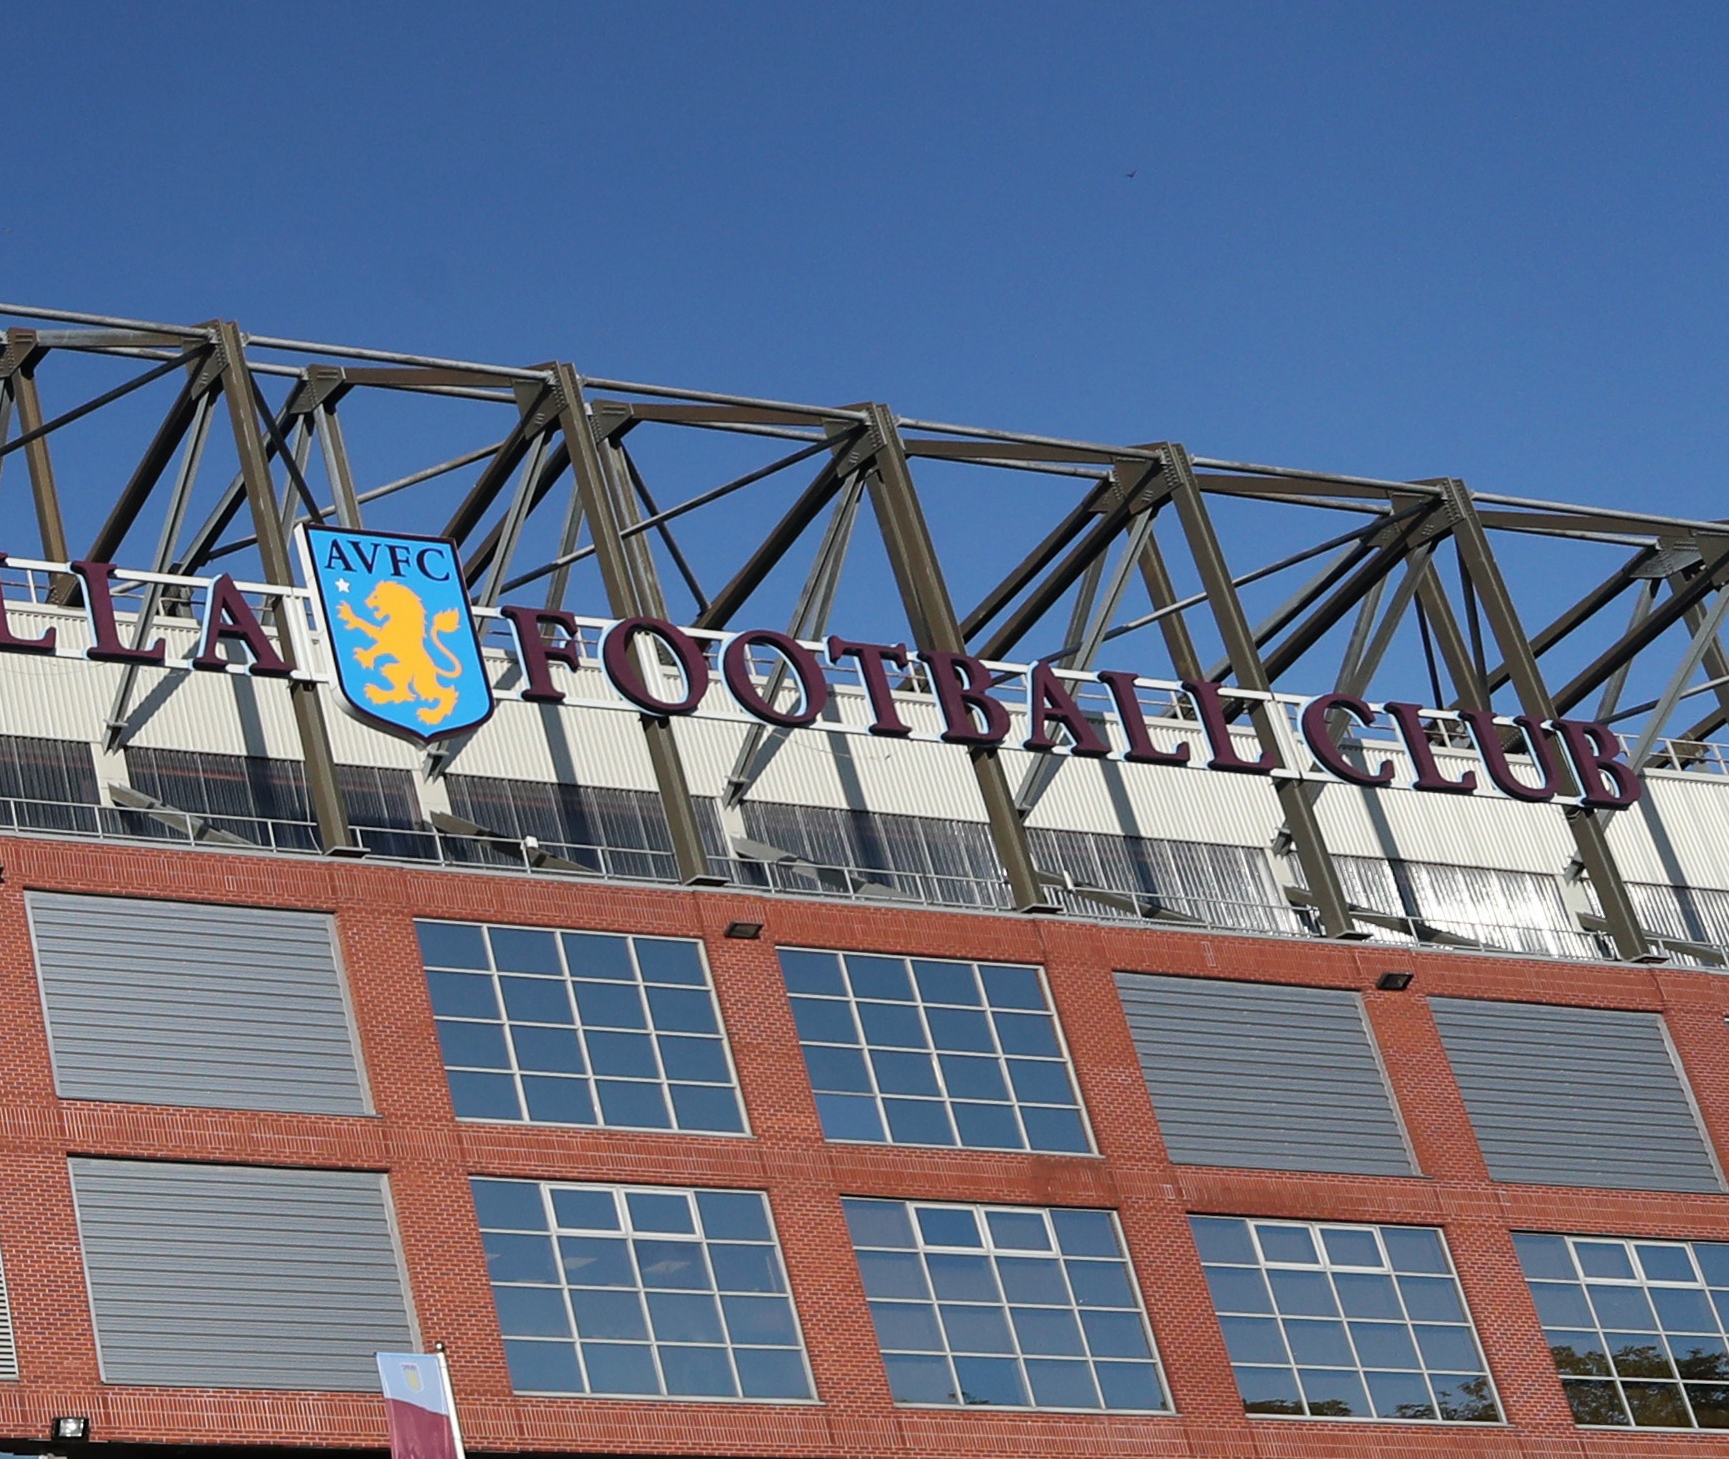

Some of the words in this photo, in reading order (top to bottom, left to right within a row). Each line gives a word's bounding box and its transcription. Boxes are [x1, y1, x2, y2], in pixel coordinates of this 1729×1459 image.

[325, 538, 450, 581] AVFC
[501, 604, 1275, 773] FOOTBALL
[1297, 693, 1642, 810] CLUB
